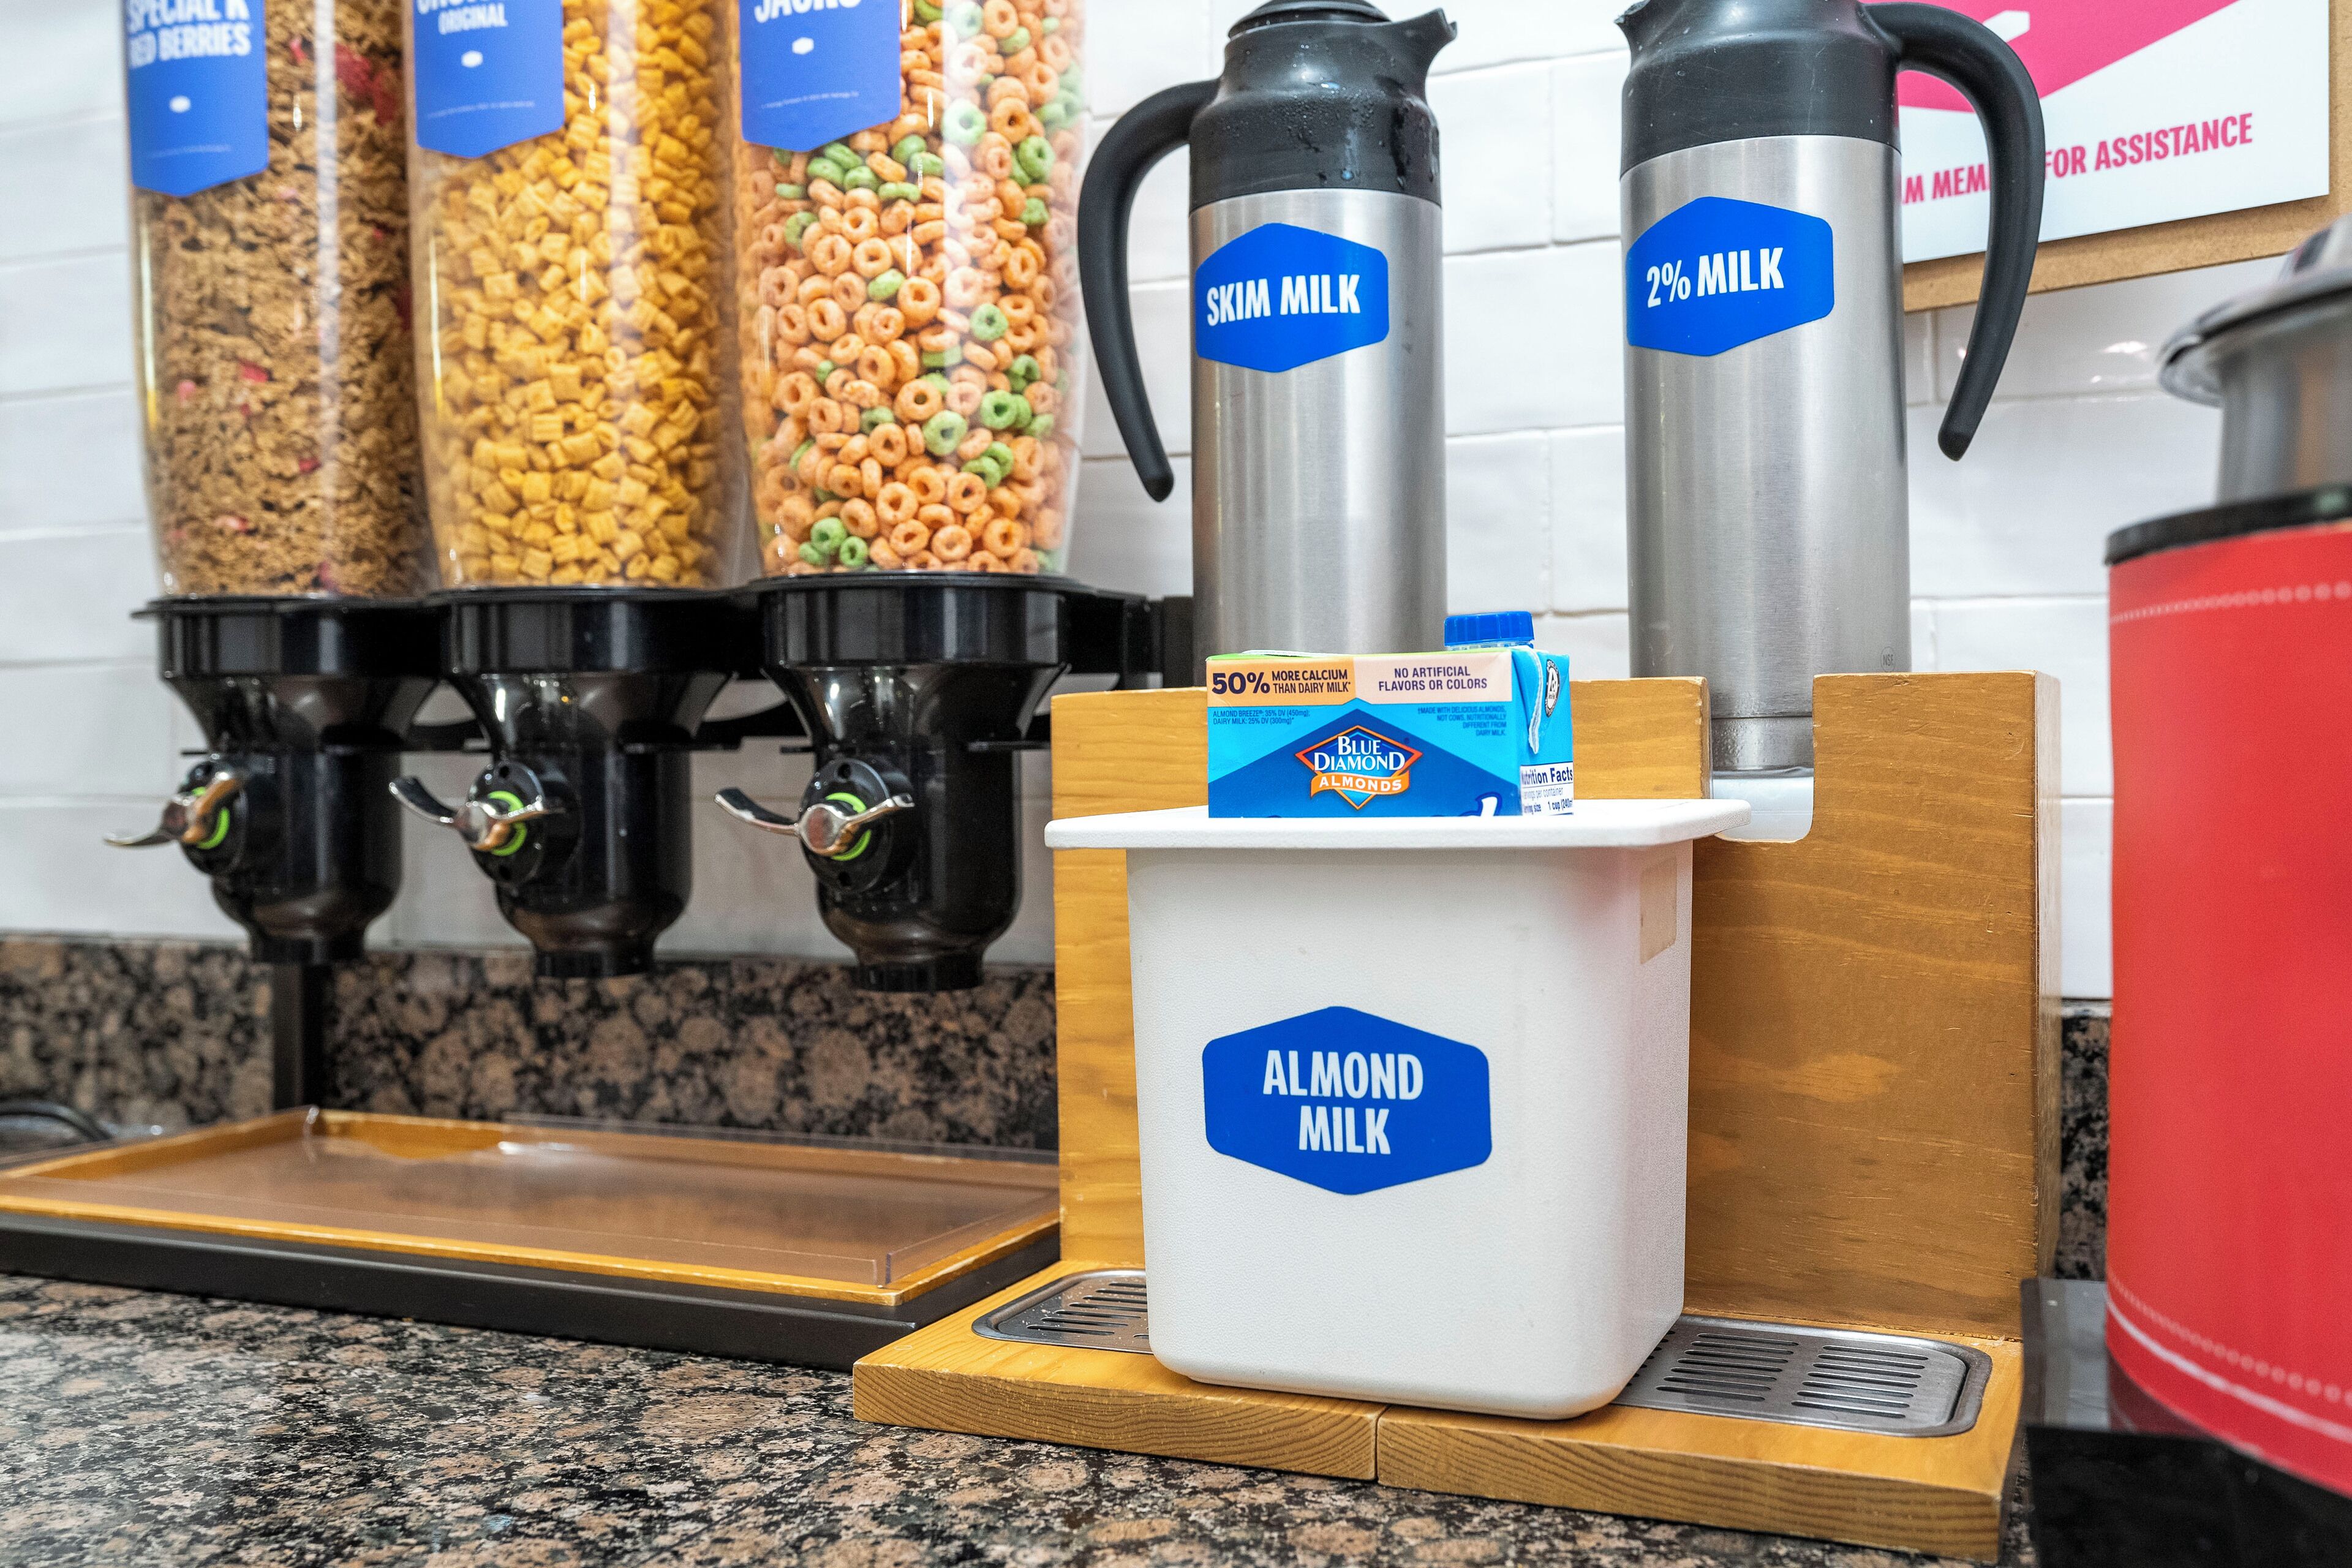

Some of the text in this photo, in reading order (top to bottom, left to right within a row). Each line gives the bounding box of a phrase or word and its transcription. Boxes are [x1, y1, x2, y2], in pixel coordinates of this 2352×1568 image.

[438, 2, 509, 35] ORIGINAL
[159, 23, 252, 61] BERRIES
[1932, 163, 1991, 200] MEM
[2094, 113, 2253, 172] ASSISTANCE
[1646, 247, 1784, 308] 2% MILK
[1206, 274, 1361, 326] SKIM MILK
[1272, 669, 1348, 681] MORE CALCIUM
[1394, 666, 1471, 678] NO ARTIFICIAL
[1211, 671, 1270, 695] 50%
[1273, 682, 1297, 693] THAN
[1298, 682, 1324, 693] DAIRY
[1379, 678, 1487, 691] FLAVORS OR COLORS
[1338, 736, 1382, 755] BLUE
[1314, 752, 1406, 771] DIAMOND
[1319, 775, 1403, 792] ALMONDS
[1550, 766, 1573, 783] Facts
[1543, 786, 1563, 797] container
[1552, 801, 1561, 812] cup
[1262, 1049, 1424, 1101] ALMOND
[1298, 1105, 1391, 1155] MILK
